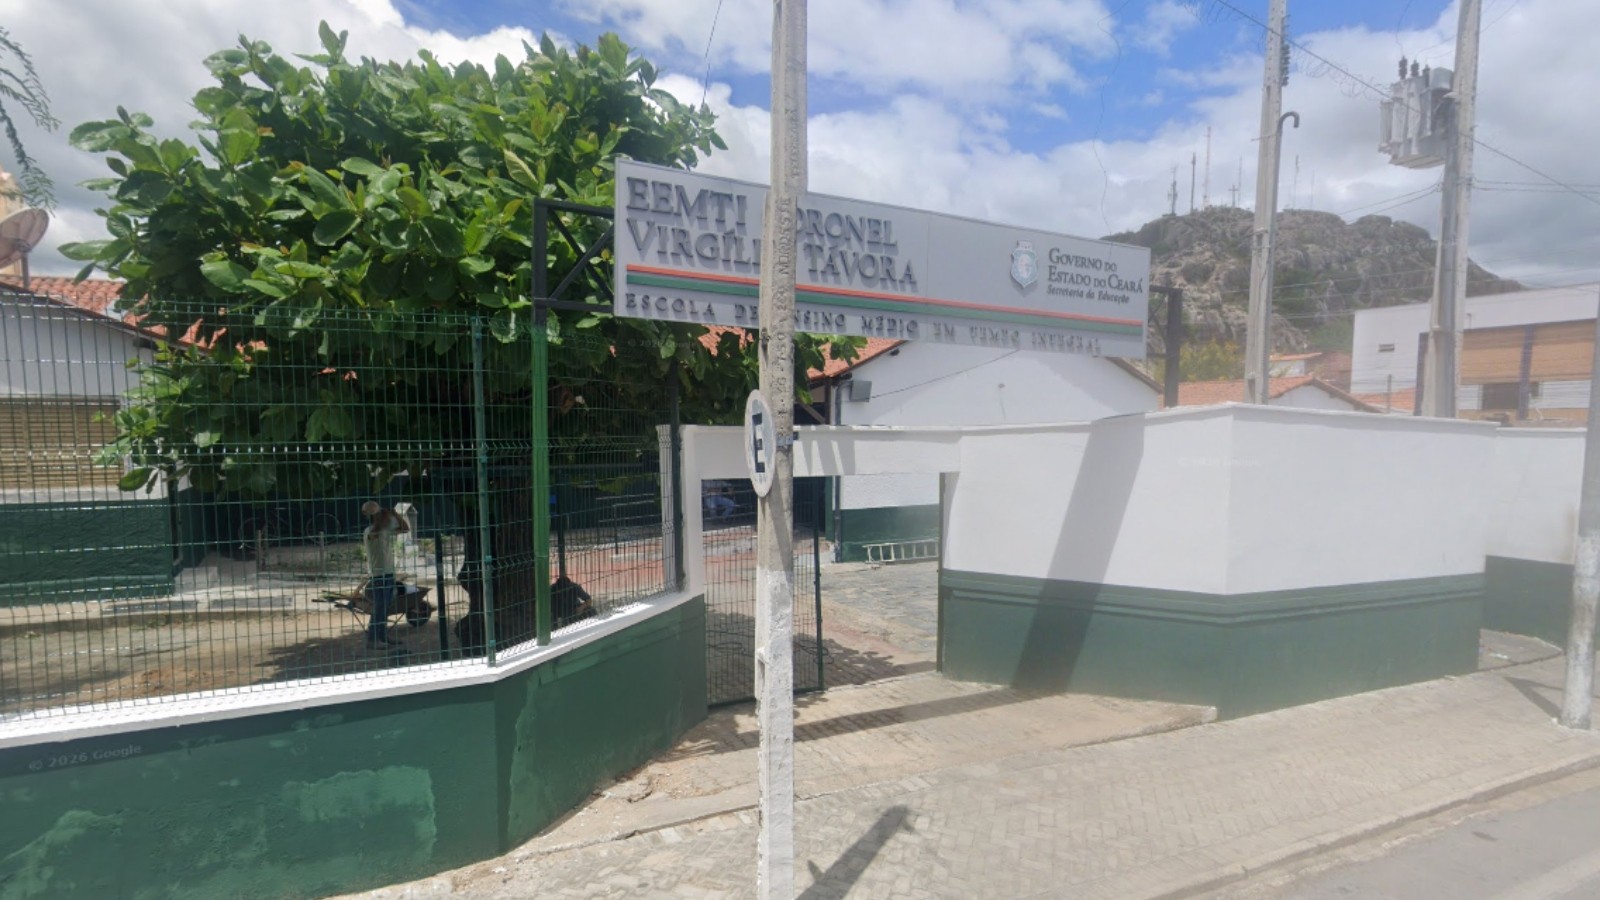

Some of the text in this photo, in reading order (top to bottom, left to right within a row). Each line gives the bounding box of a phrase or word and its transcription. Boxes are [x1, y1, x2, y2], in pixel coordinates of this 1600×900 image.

[627, 177, 897, 248] EEMTI ORONEL
[627, 218, 917, 285] VIRGÍLI TÁVORA
[1048, 248, 1102, 271] GOVERNO
[1048, 265, 1091, 286] ESTADO
[1108, 273, 1143, 294] CEARÁ
[626, 293, 715, 317] ESCOLA
[795, 309, 846, 327] NSINO
[752, 411, 765, 473] E
